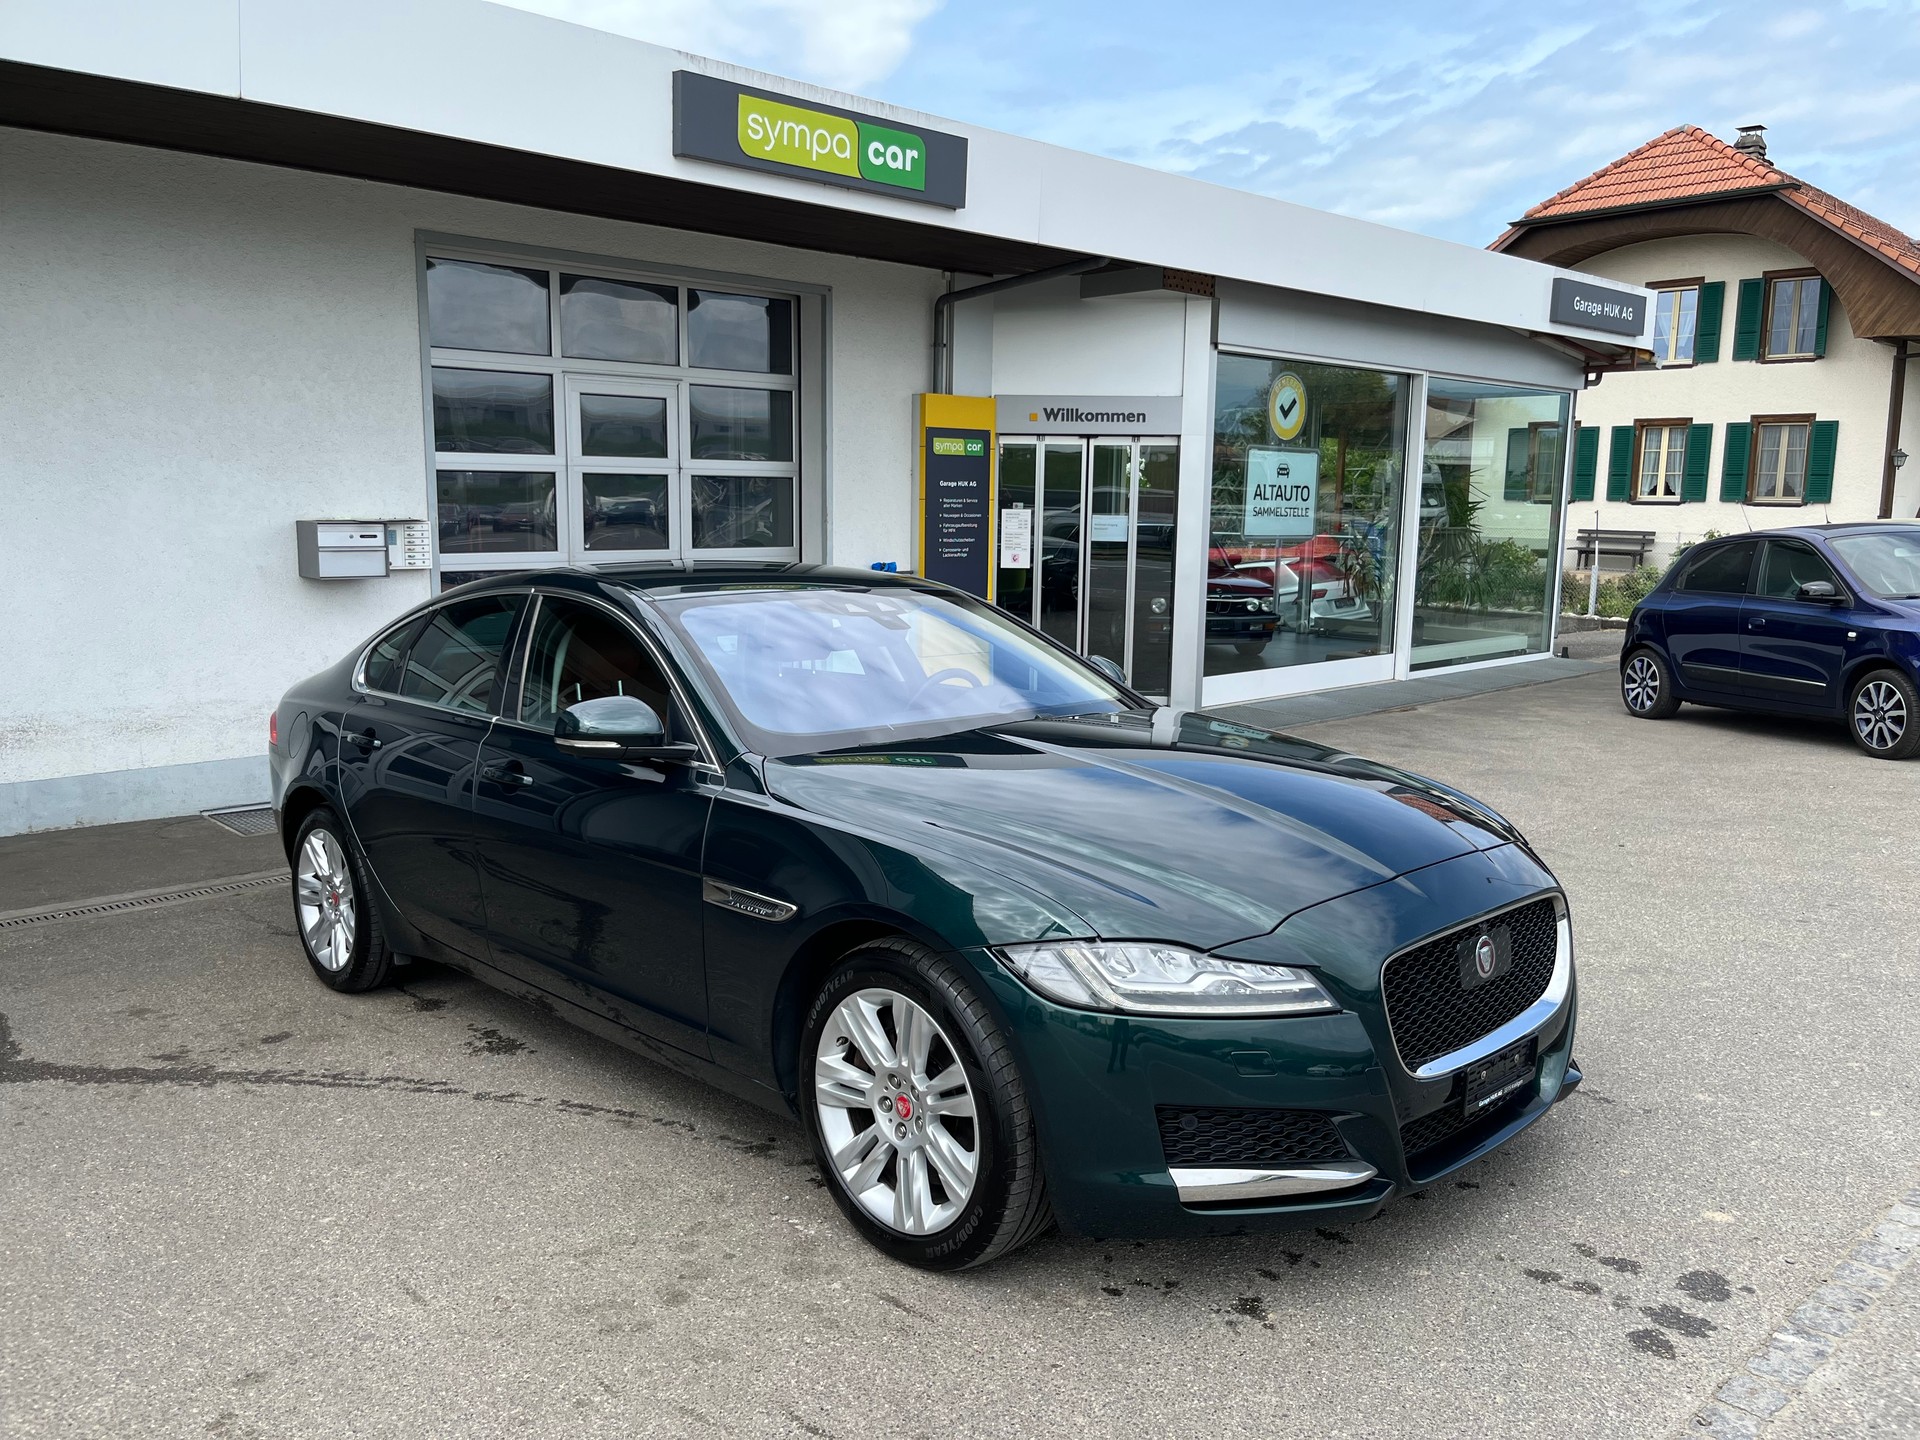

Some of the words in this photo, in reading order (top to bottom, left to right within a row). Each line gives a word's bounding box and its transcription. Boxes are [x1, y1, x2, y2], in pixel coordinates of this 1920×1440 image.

[747, 113, 851, 161] sympa
[867, 141, 918, 171] car
[1573, 296, 1602, 316] Garage
[1603, 302, 1620, 318] HUK
[1621, 306, 1633, 321] AG
[1043, 407, 1147, 423] Willkommen
[935, 442, 963, 453] sympa
[967, 443, 981, 451] car
[939, 480, 957, 488] Garage
[1253, 484, 1310, 502] ALTAUTO
[1252, 506, 1309, 517] SAMMELSTELLE
[729, 901, 766, 915] JAGUAR
[808, 970, 854, 1029] GOODYEAR
[925, 1205, 984, 1258] GOODYEAR
